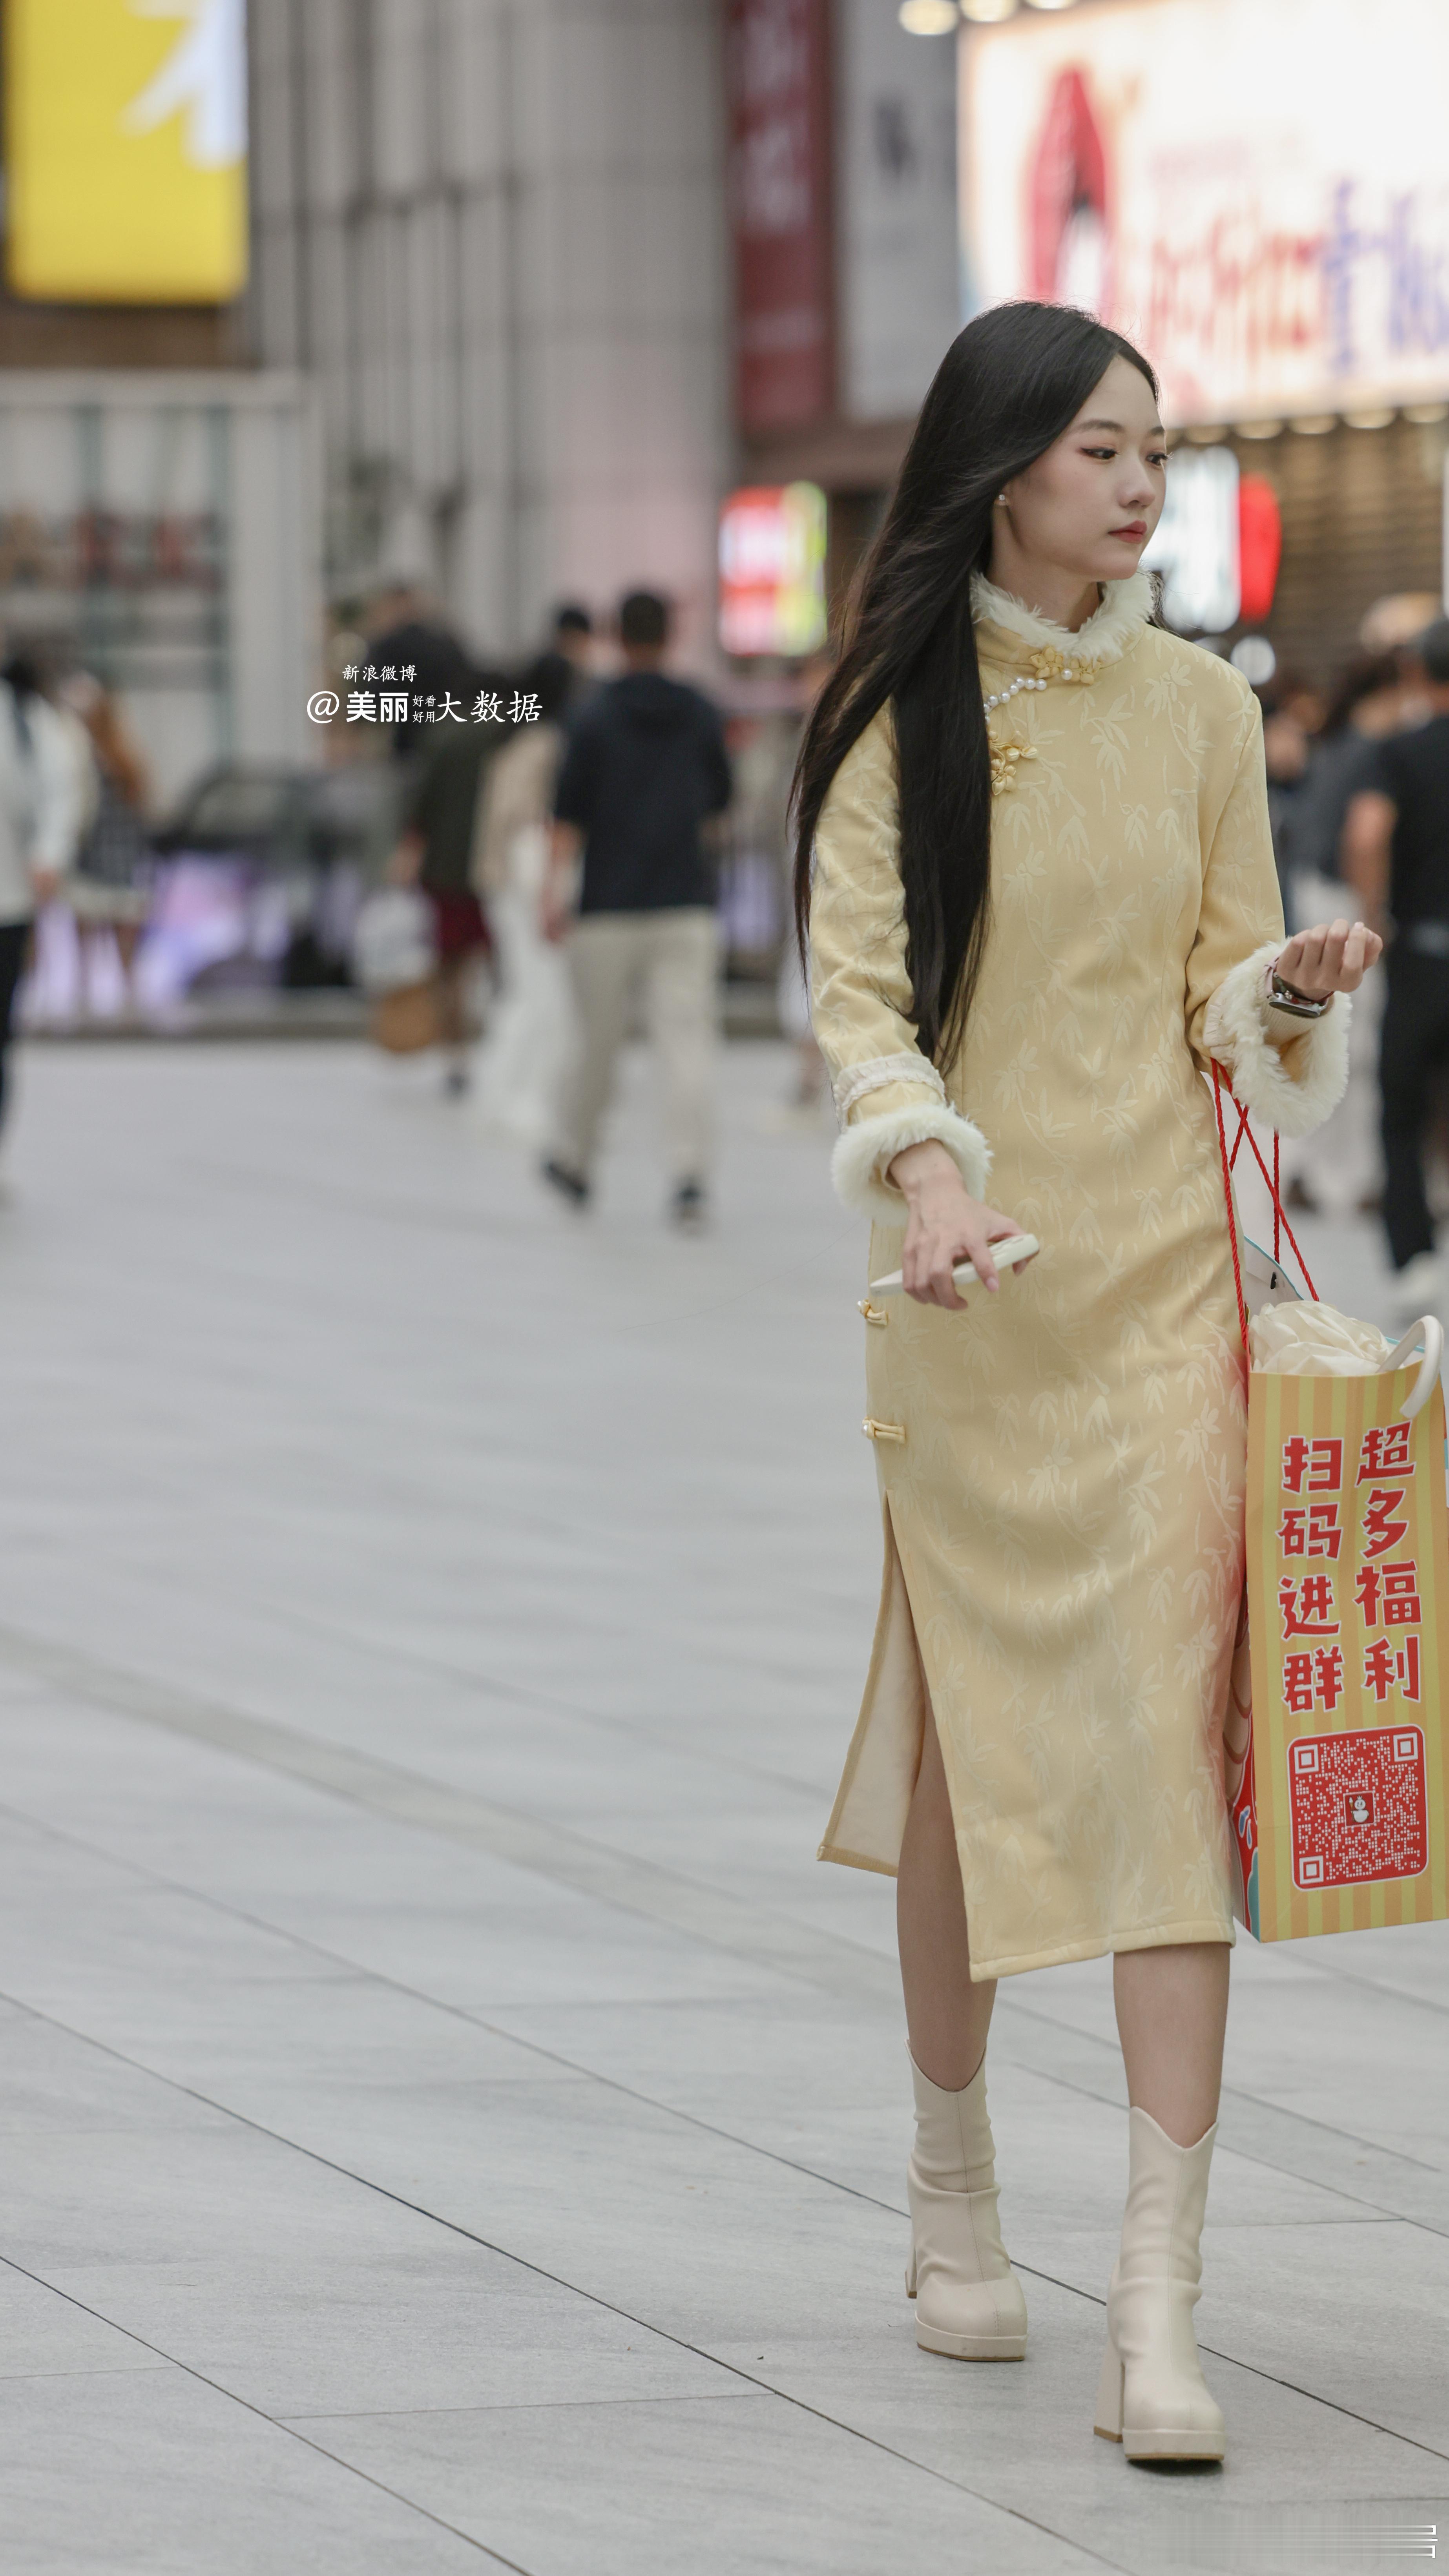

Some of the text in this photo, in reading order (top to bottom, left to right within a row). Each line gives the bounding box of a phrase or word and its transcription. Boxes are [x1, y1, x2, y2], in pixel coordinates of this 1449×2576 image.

[1276, 1436, 1345, 1714] 扫码进群
[1353, 1420, 1422, 1702] 超多福利
